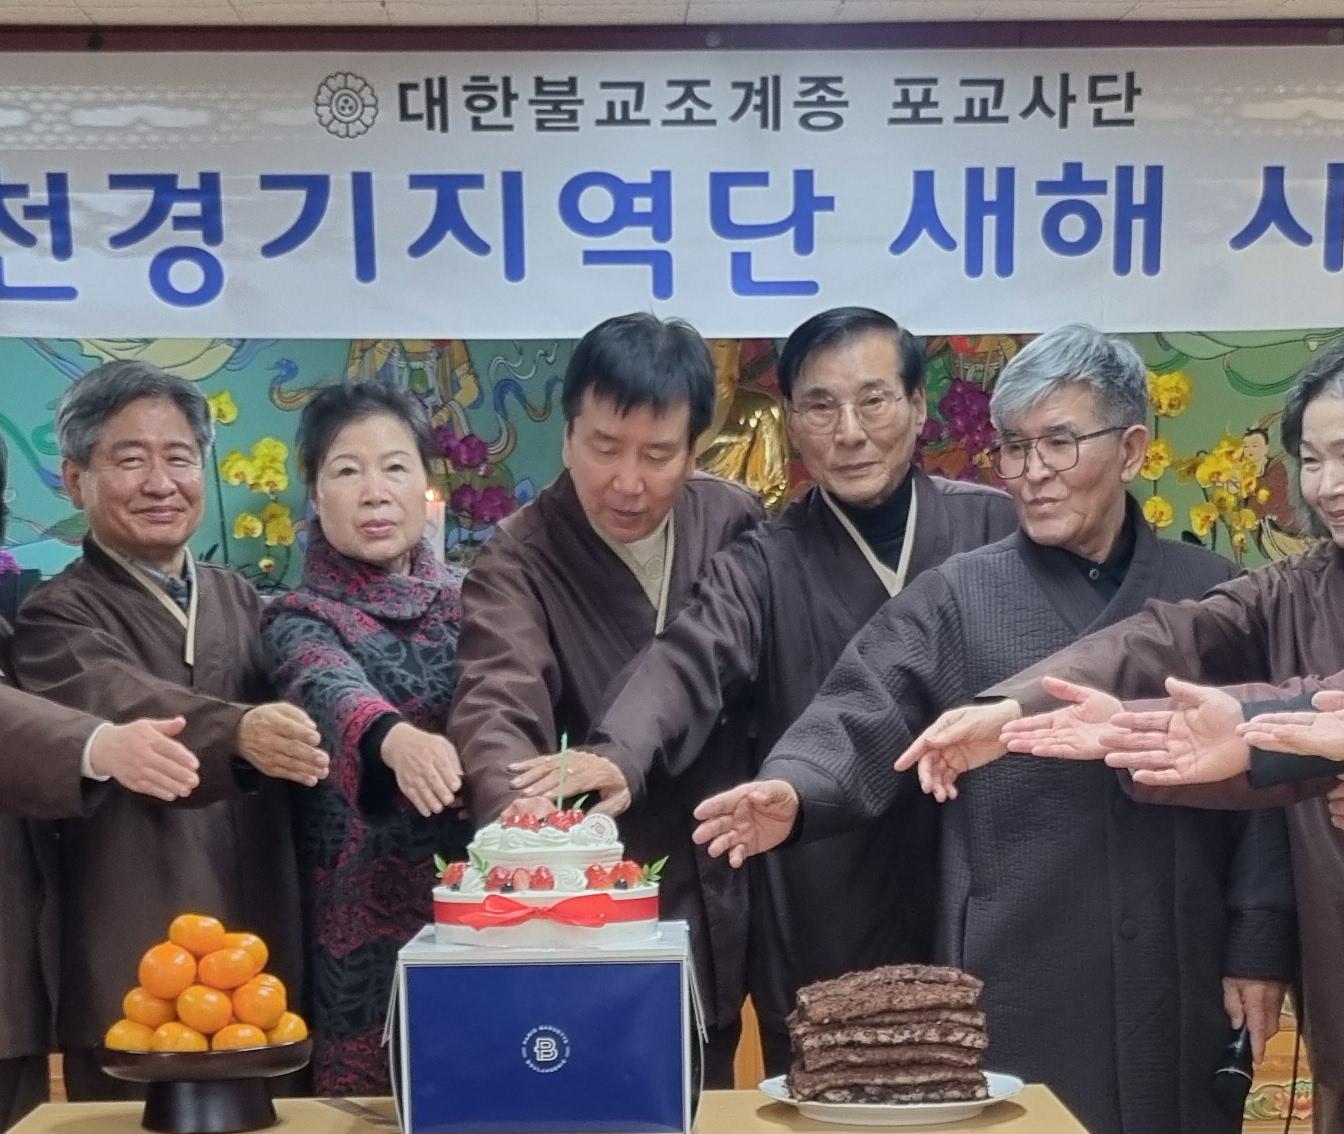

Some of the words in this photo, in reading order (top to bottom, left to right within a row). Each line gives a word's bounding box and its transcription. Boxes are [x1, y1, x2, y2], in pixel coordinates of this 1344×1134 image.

[398, 74, 850, 134] 대한불교조계종
[887, 71, 1143, 130] 포교사단
[888, 161, 1164, 279] 새해
